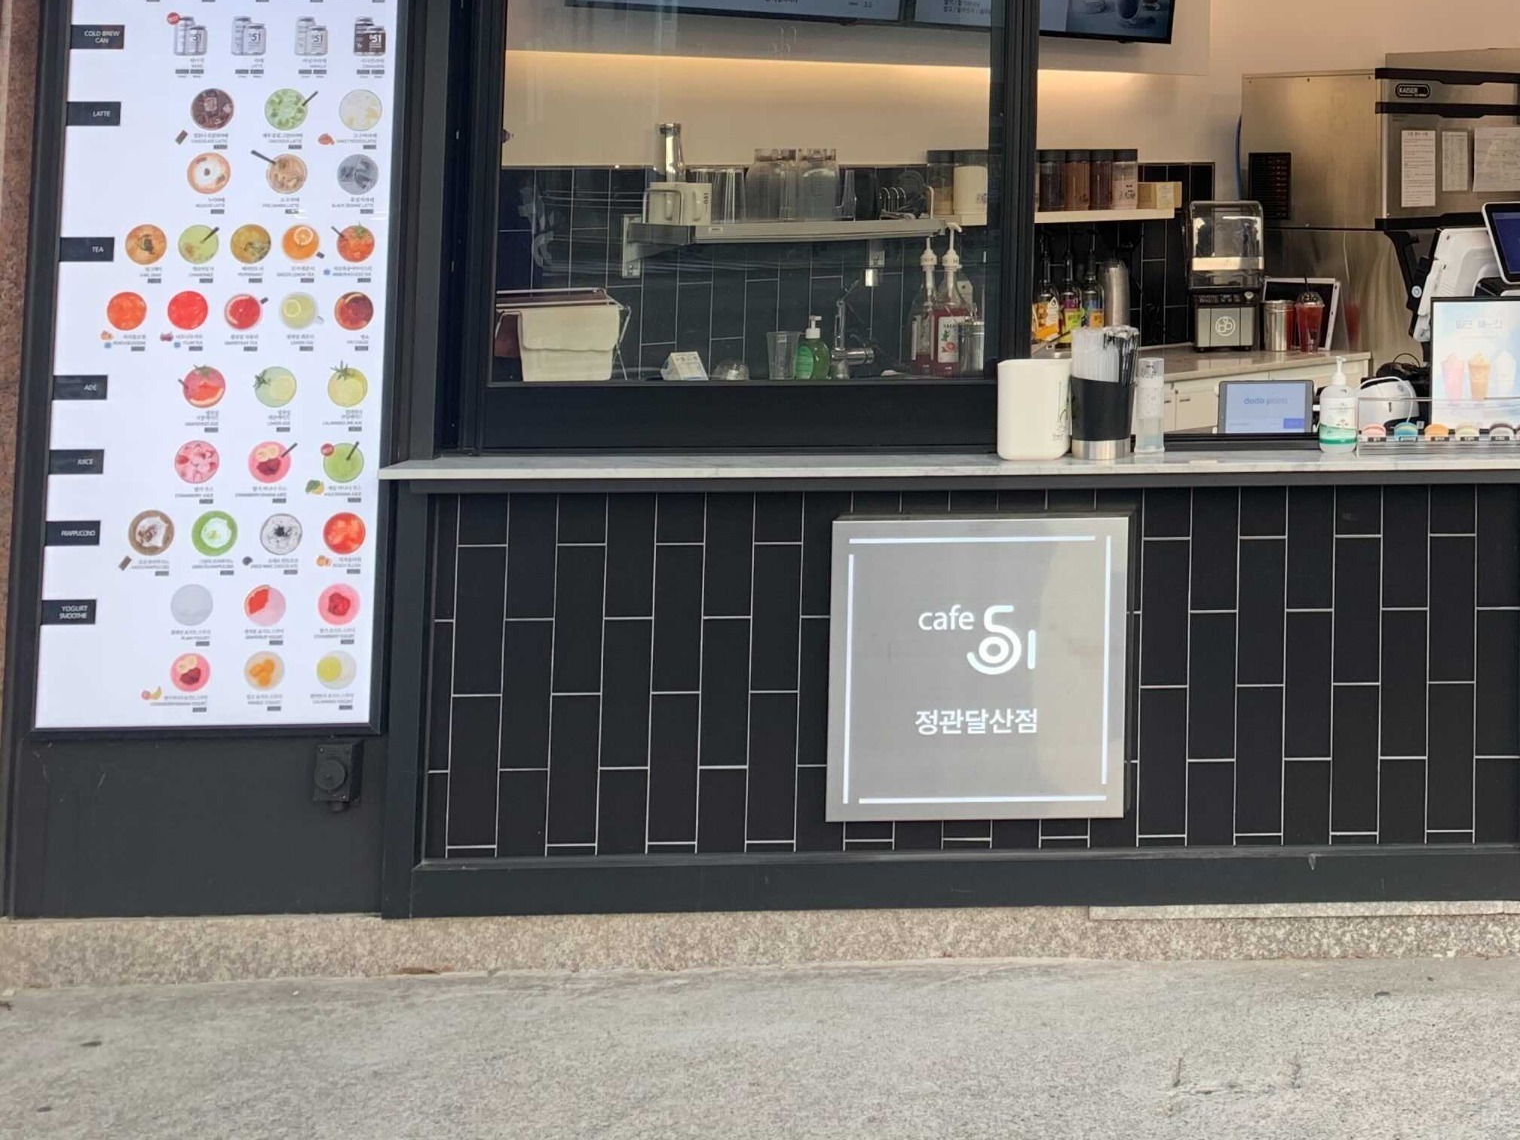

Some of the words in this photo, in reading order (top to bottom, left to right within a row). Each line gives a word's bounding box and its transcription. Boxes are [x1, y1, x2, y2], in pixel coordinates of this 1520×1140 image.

[92, 110, 111, 118] LATTE
[77, 458, 94, 466] JUICE
[918, 604, 975, 631] cafe
[915, 708, 1038, 735] 정관달산점
